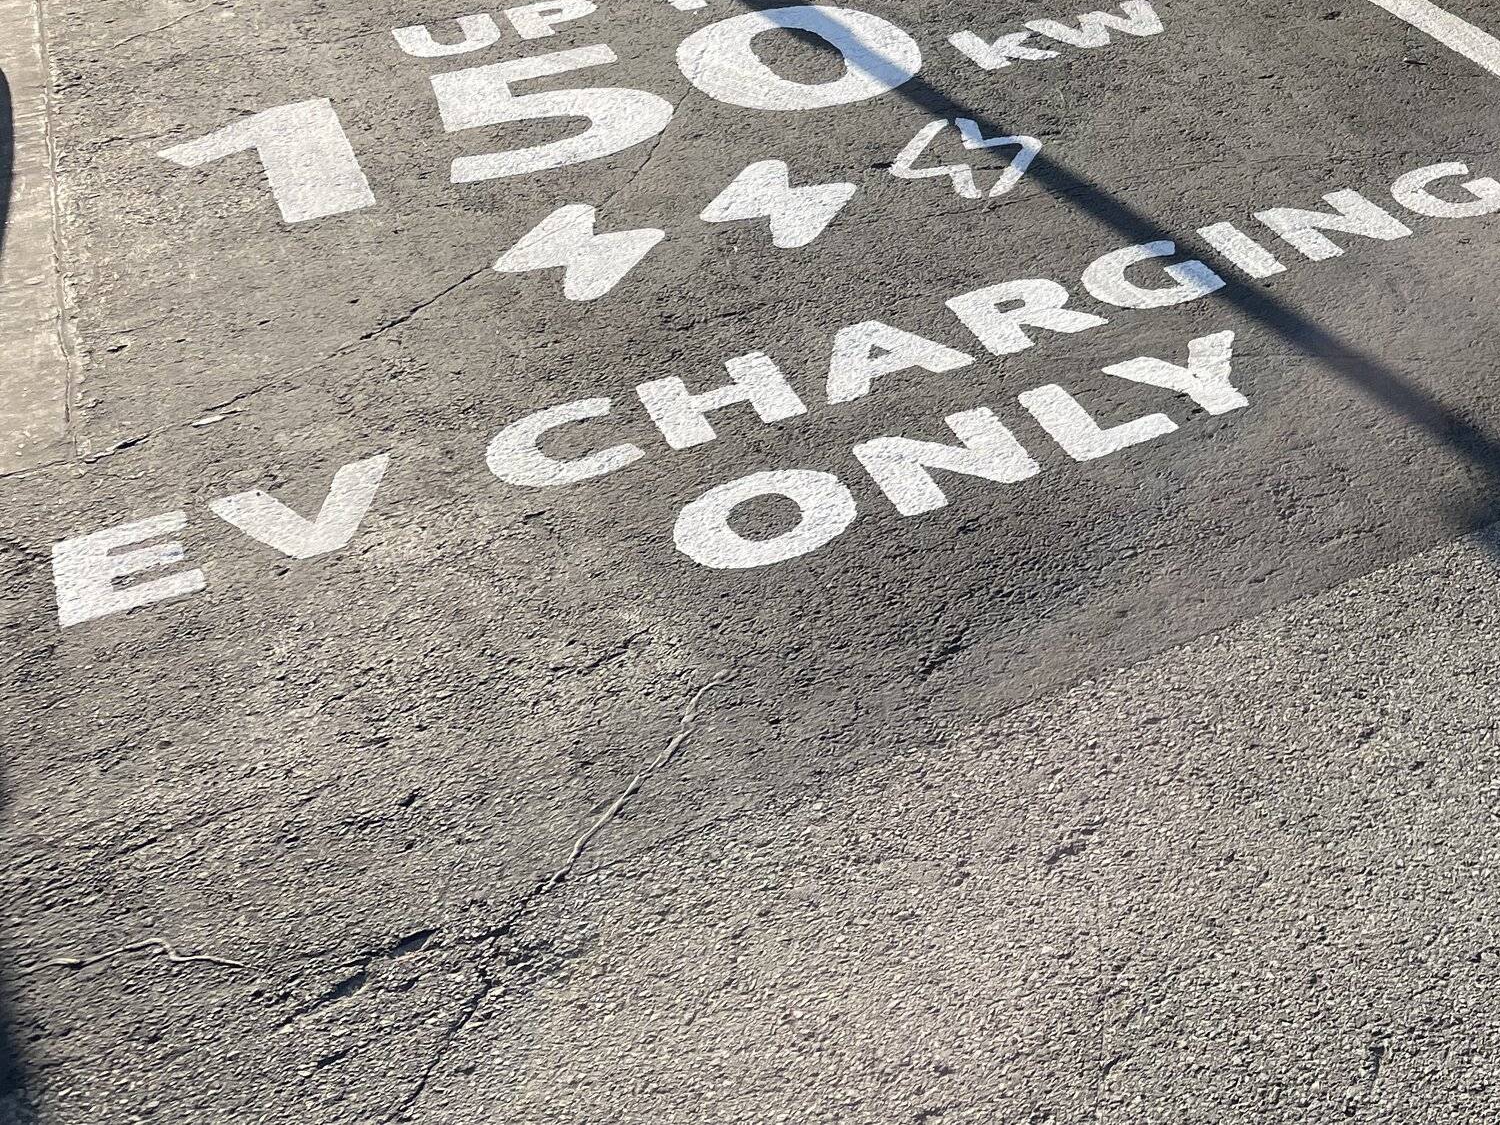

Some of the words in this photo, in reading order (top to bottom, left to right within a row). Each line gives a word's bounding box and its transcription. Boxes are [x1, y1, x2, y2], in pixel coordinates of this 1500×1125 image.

[155, 5, 922, 223] 150
[52, 453, 391, 627] EV
[674, 330, 1249, 569] ONLY
